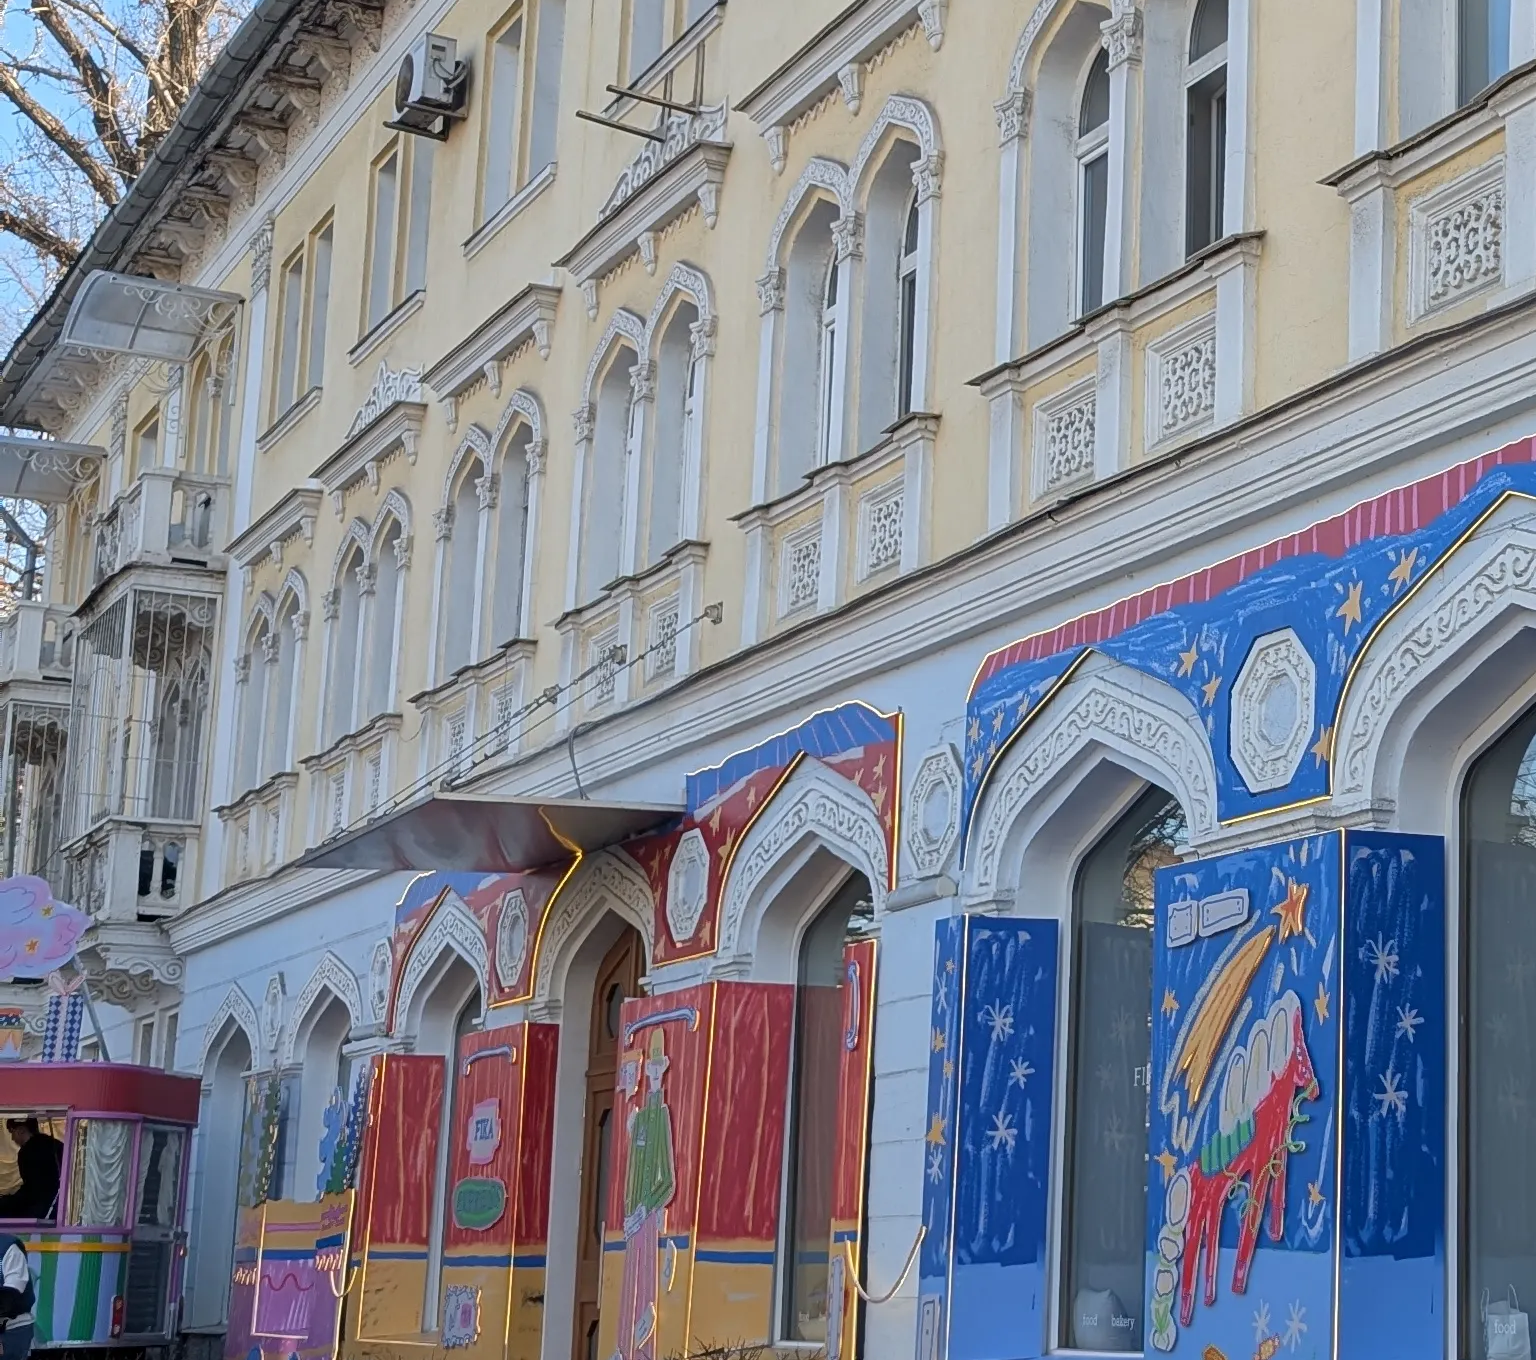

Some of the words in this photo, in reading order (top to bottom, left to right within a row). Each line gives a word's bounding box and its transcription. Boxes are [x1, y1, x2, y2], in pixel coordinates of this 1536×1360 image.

[1133, 1065, 1150, 1087] FI
[474, 1117, 495, 1142] FIKA
[1081, 1313, 1098, 1327] food
[1111, 1312, 1135, 1331] bakery
[1493, 1319, 1517, 1335] food
